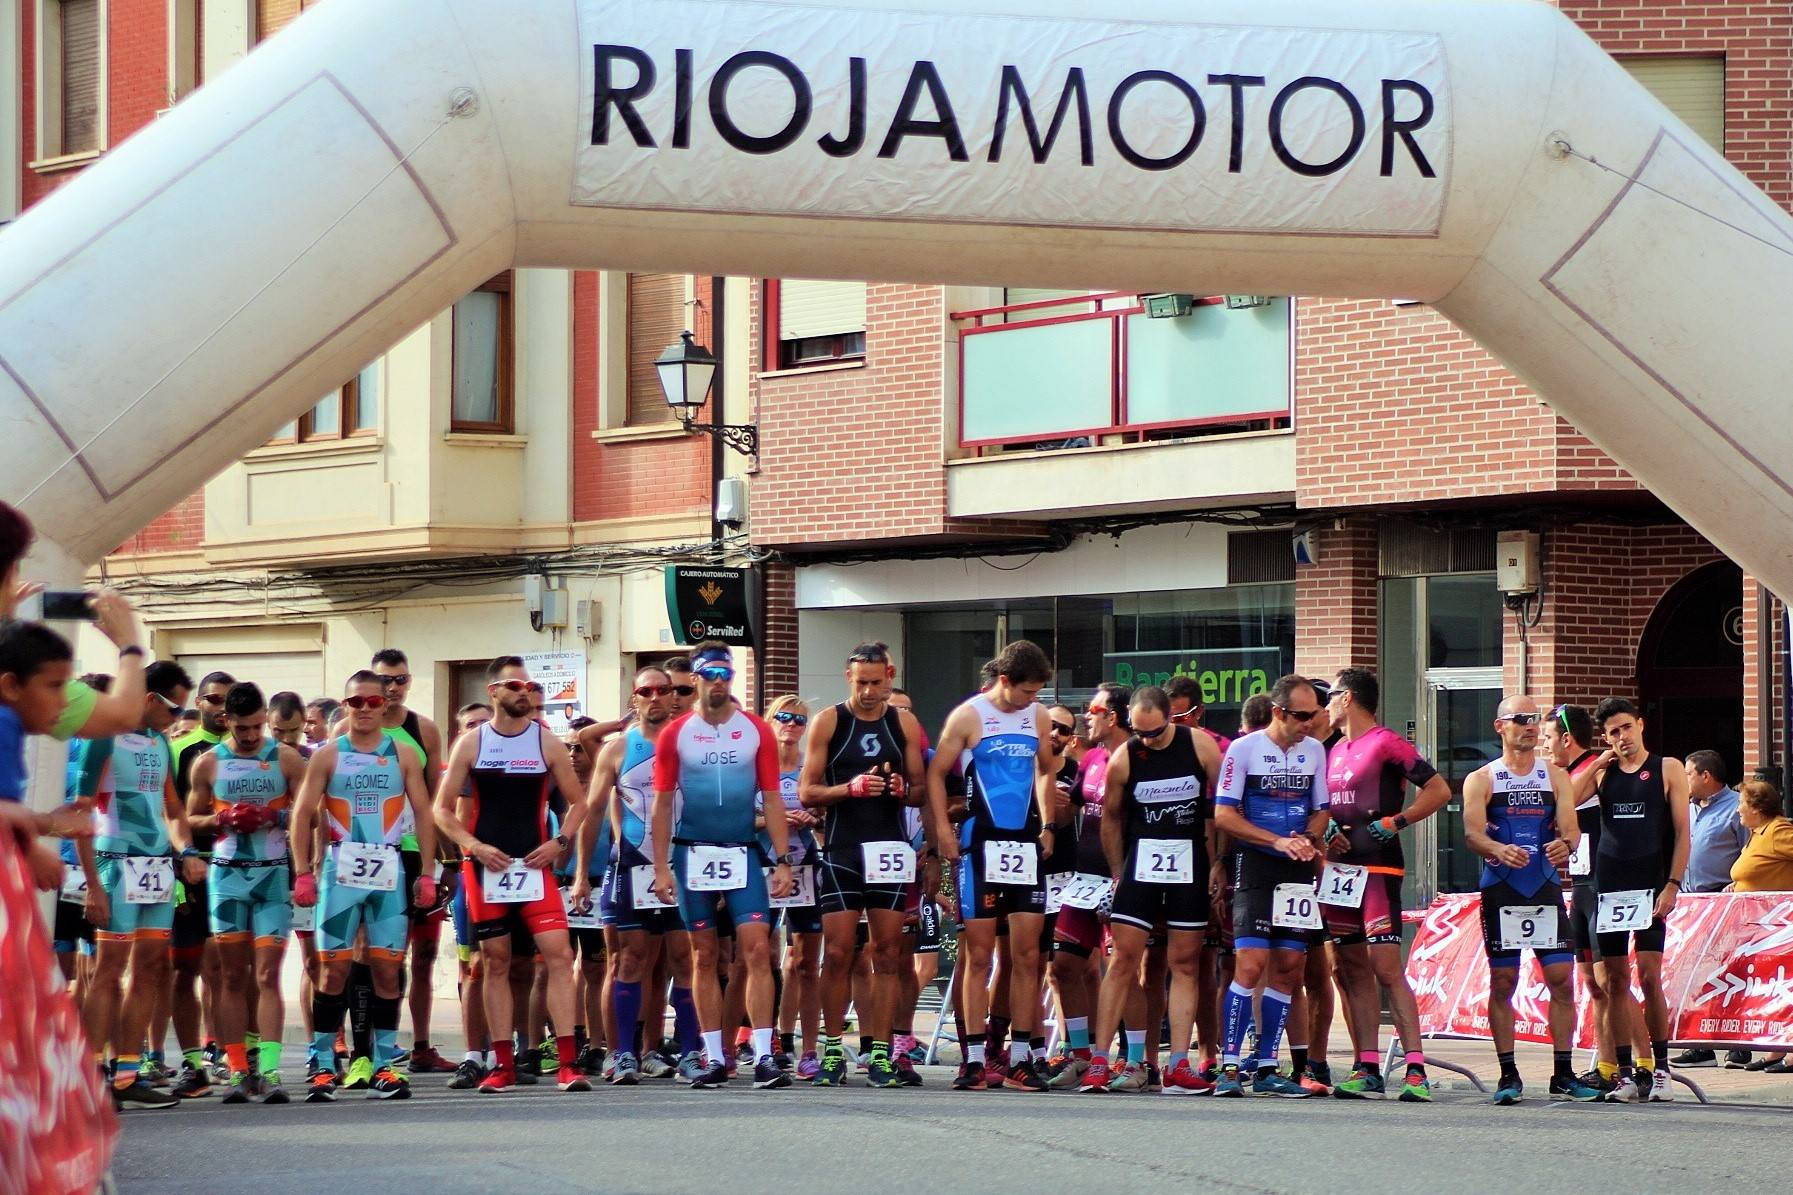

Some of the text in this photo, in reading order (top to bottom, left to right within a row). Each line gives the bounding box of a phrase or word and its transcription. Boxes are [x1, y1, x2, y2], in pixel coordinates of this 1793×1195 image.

[589, 43, 1438, 178] RIOJAMOTOR
[680, 570, 702, 578] CAJERO
[707, 625, 744, 637] ServiRed
[547, 681, 575, 694] 677 552
[134, 752, 162, 768] DIEGO
[480, 759, 510, 768] hogar
[701, 750, 738, 765] JOSE
[345, 774, 390, 790] A.GOMEZ
[1222, 757, 1234, 791] MUNDO
[1260, 775, 1310, 790] CASTRILLEJO
[227, 775, 276, 794] MARUGÁN
[1505, 780, 1541, 790] Camellia
[1508, 791, 1544, 806] GURREA
[352, 858, 385, 877] 37
[702, 861, 733, 880] 45
[880, 853, 904, 872] 55
[1000, 853, 1024, 873] 52
[1152, 853, 1178, 872] 21
[138, 871, 163, 892] 41
[498, 871, 529, 891] 47
[1331, 876, 1354, 896] 14
[1071, 885, 1097, 901] 12
[1285, 898, 1312, 917] 10
[1611, 904, 1639, 923] 57
[1521, 919, 1535, 938] 9
[1743, 1019, 1765, 1034] EVERY
